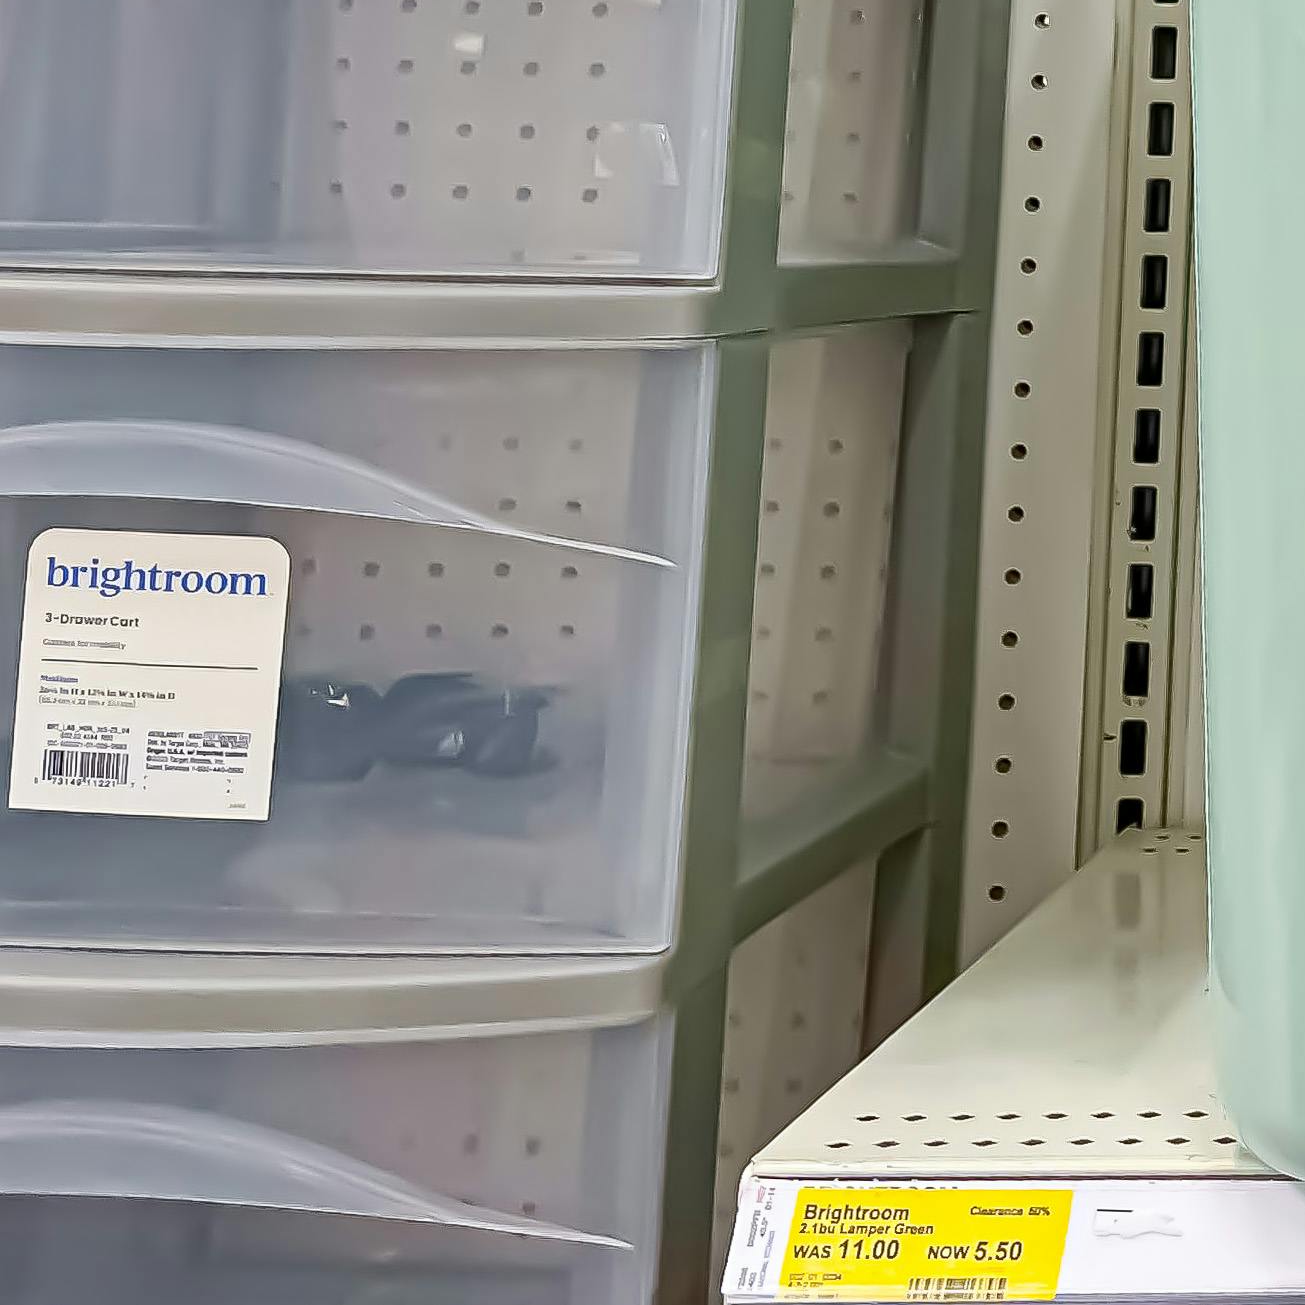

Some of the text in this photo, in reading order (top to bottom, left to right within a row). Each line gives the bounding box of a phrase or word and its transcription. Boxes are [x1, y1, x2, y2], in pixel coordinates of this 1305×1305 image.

[47, 557, 268, 597] brightroom
[45, 612, 140, 628] 3-Drawer Cart
[52, 776, 82, 787] 73149
[86, 778, 117, 788] 11221
[804, 1204, 909, 1225] Brightroom
[970, 1206, 1024, 1216] Clearance
[799, 1222, 934, 1237] 2.1bu Lamper Green
[793, 1238, 1023, 1261] WAS 11.00 NOW 5.50
